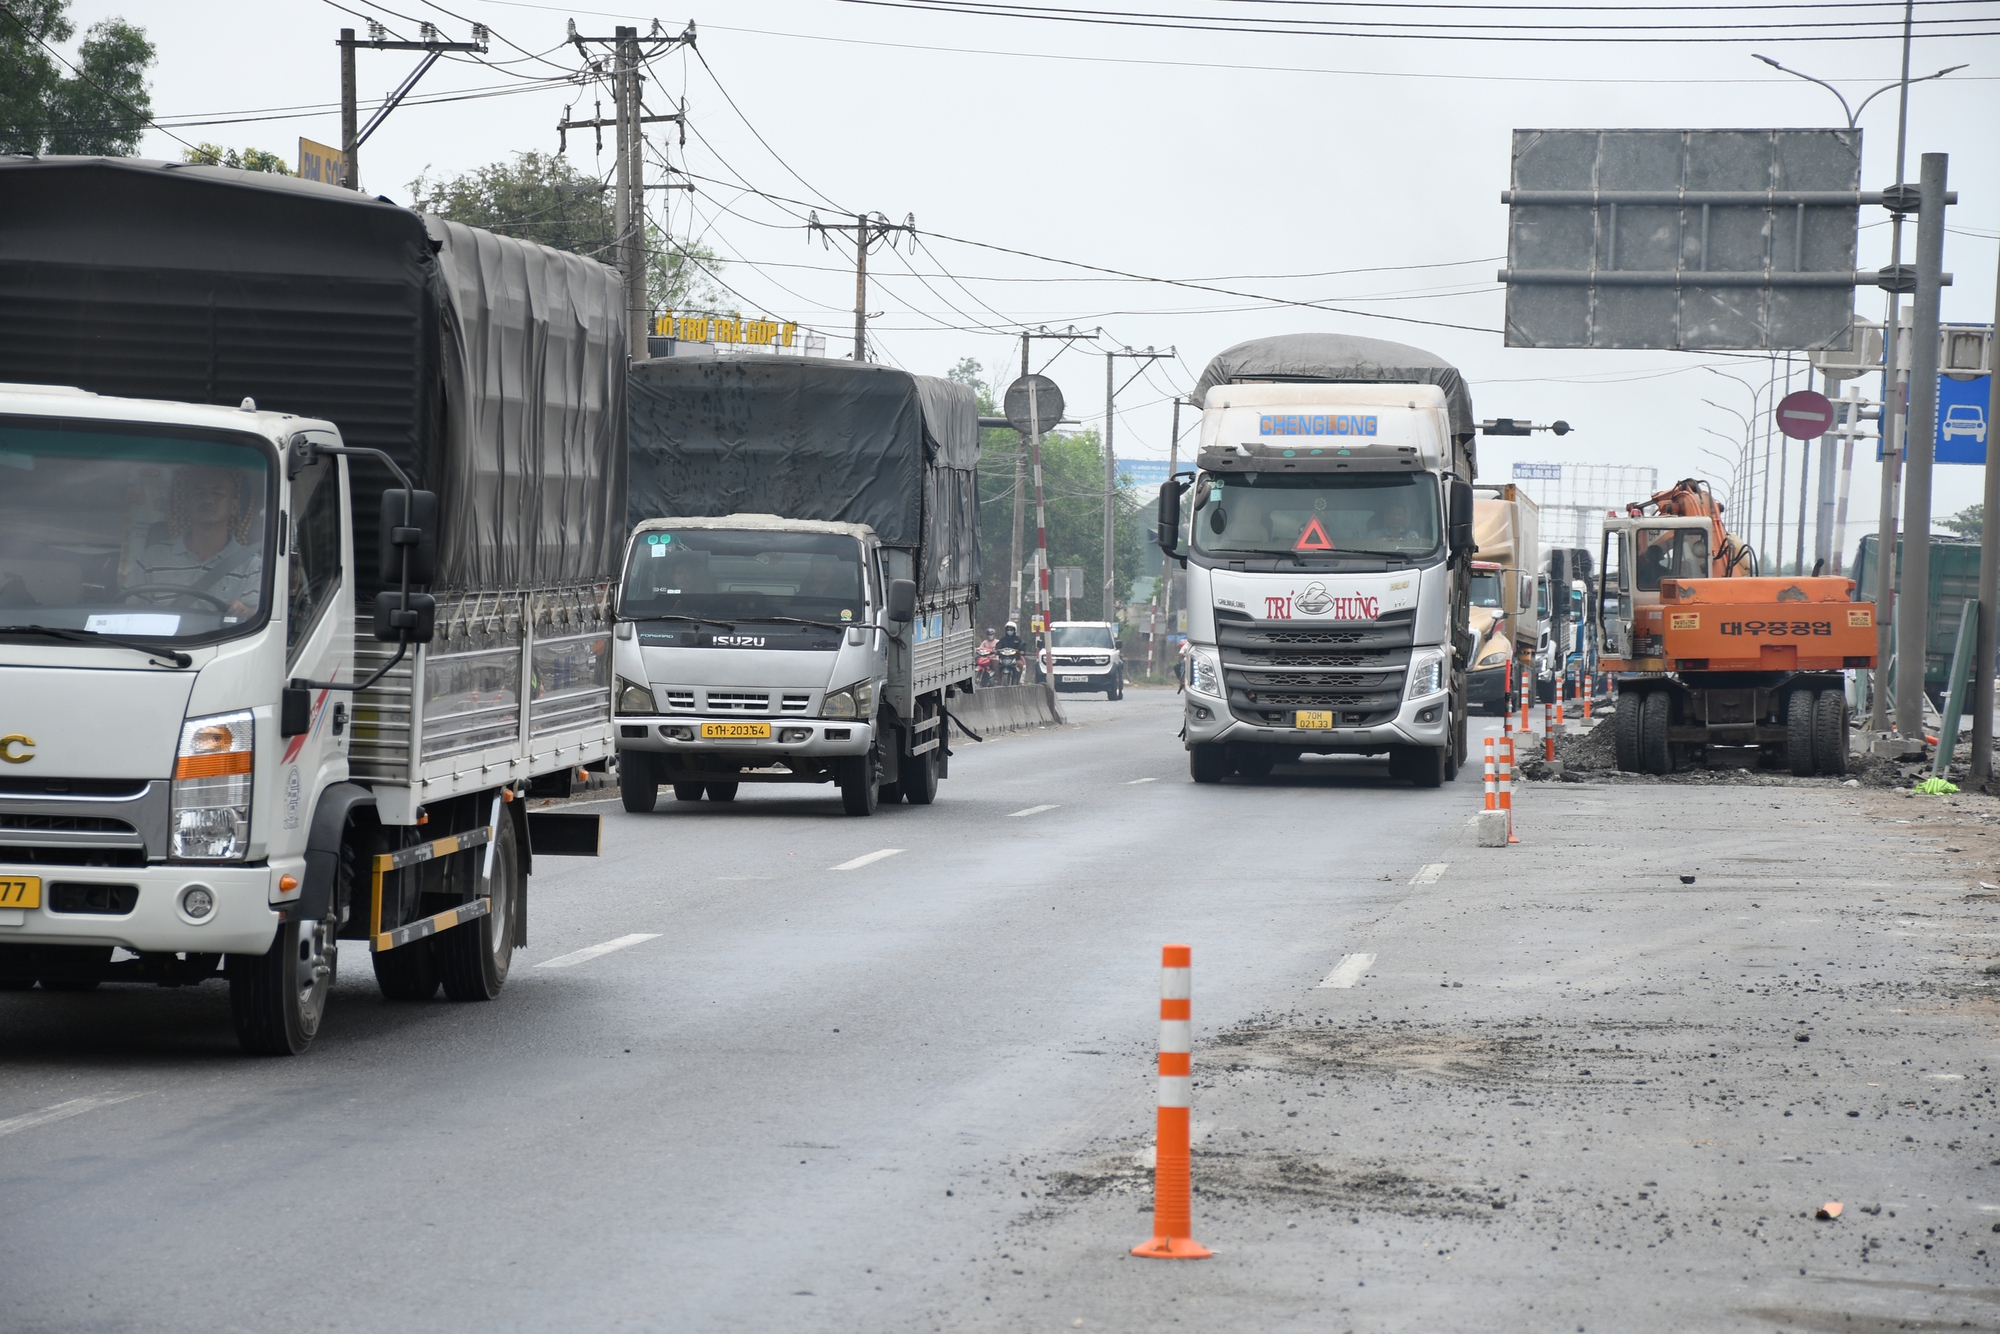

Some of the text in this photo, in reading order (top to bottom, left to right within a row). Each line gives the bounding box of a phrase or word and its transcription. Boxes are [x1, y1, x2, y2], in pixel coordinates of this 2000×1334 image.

[714, 312, 742, 343] TRẢ
[746, 316, 778, 345] GÓP
[1260, 415, 1377, 435] CHENGLONG
[1265, 590, 1294, 619] TRÍ
[1720, 621, 1831, 636] 대우중공업
[713, 636, 765, 647] ISUZU
[1307, 712, 1323, 720] 70H
[707, 725, 764, 736] 61H-203.64
[1300, 720, 1328, 728] 021.33
[0, 882, 26, 901] 77
